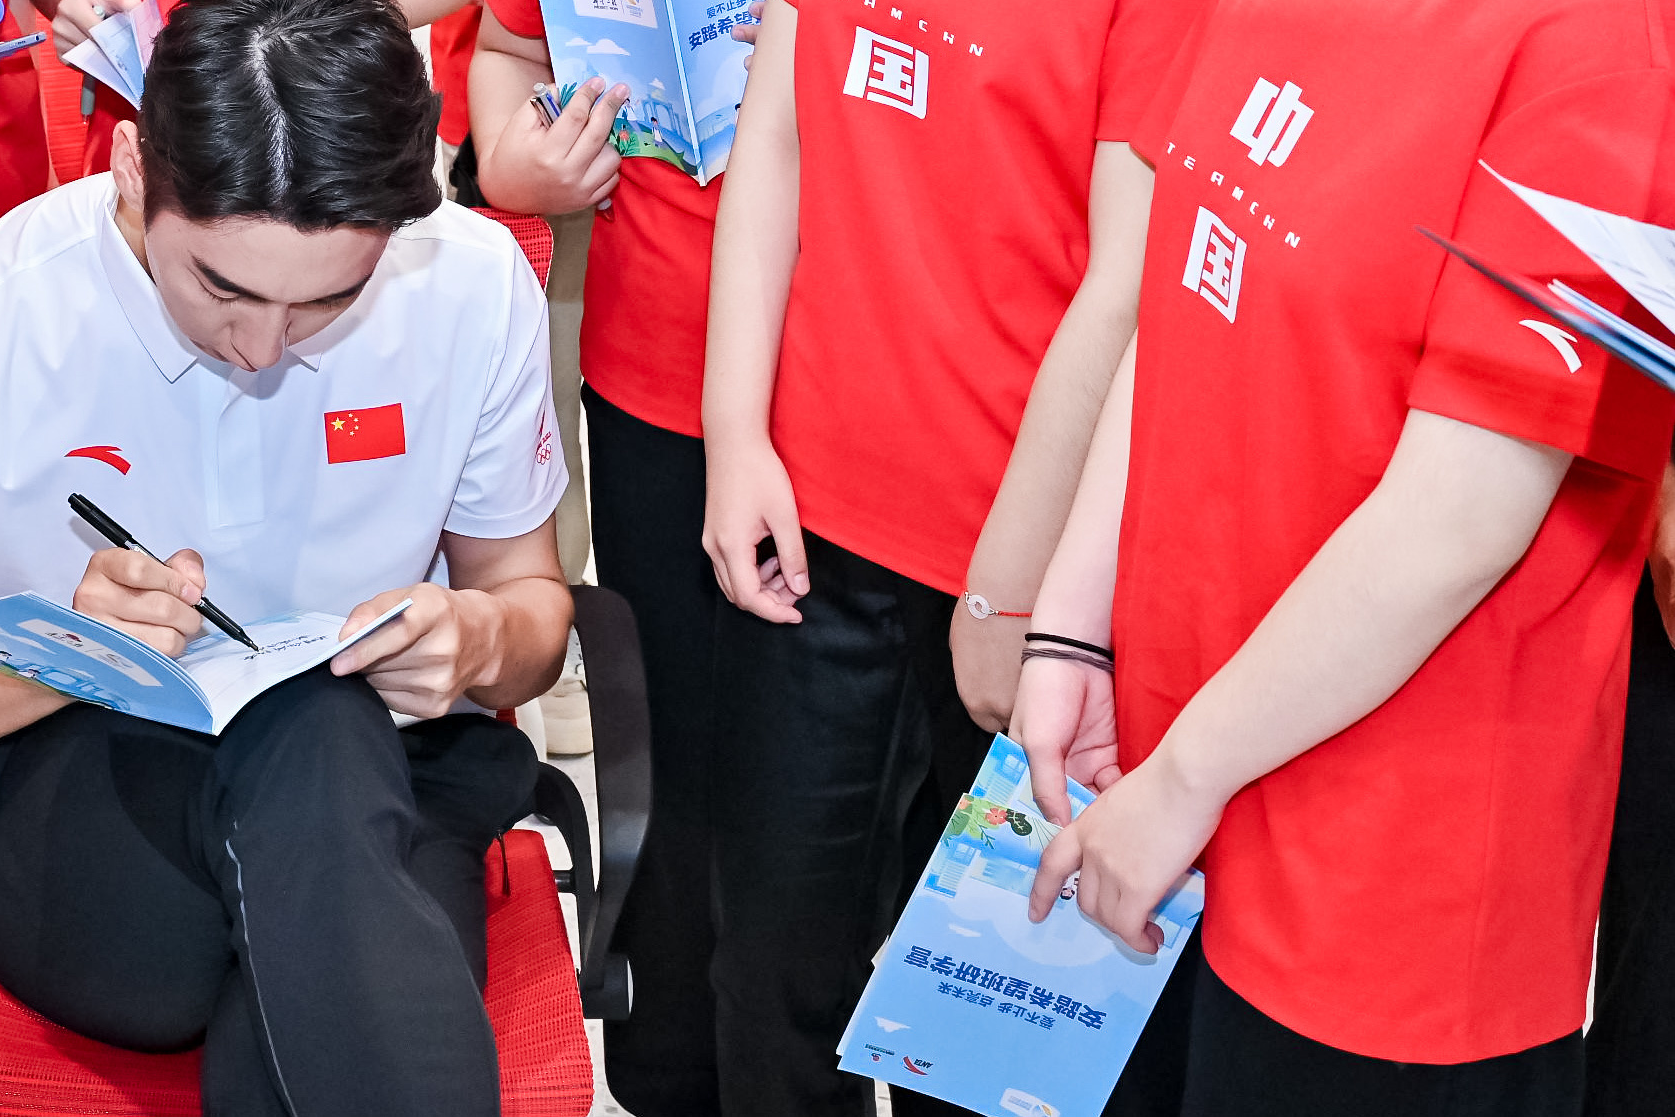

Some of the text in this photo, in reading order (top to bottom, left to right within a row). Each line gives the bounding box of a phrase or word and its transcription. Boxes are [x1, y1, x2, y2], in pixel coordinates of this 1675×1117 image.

[842, 25, 930, 119] 国
[1230, 76, 1315, 167] 中
[1181, 206, 1248, 324] 国
[904, 945, 1107, 1030] 安踏希望班研学营
[937, 981, 1057, 1031] 爱不止步 点亮未来
